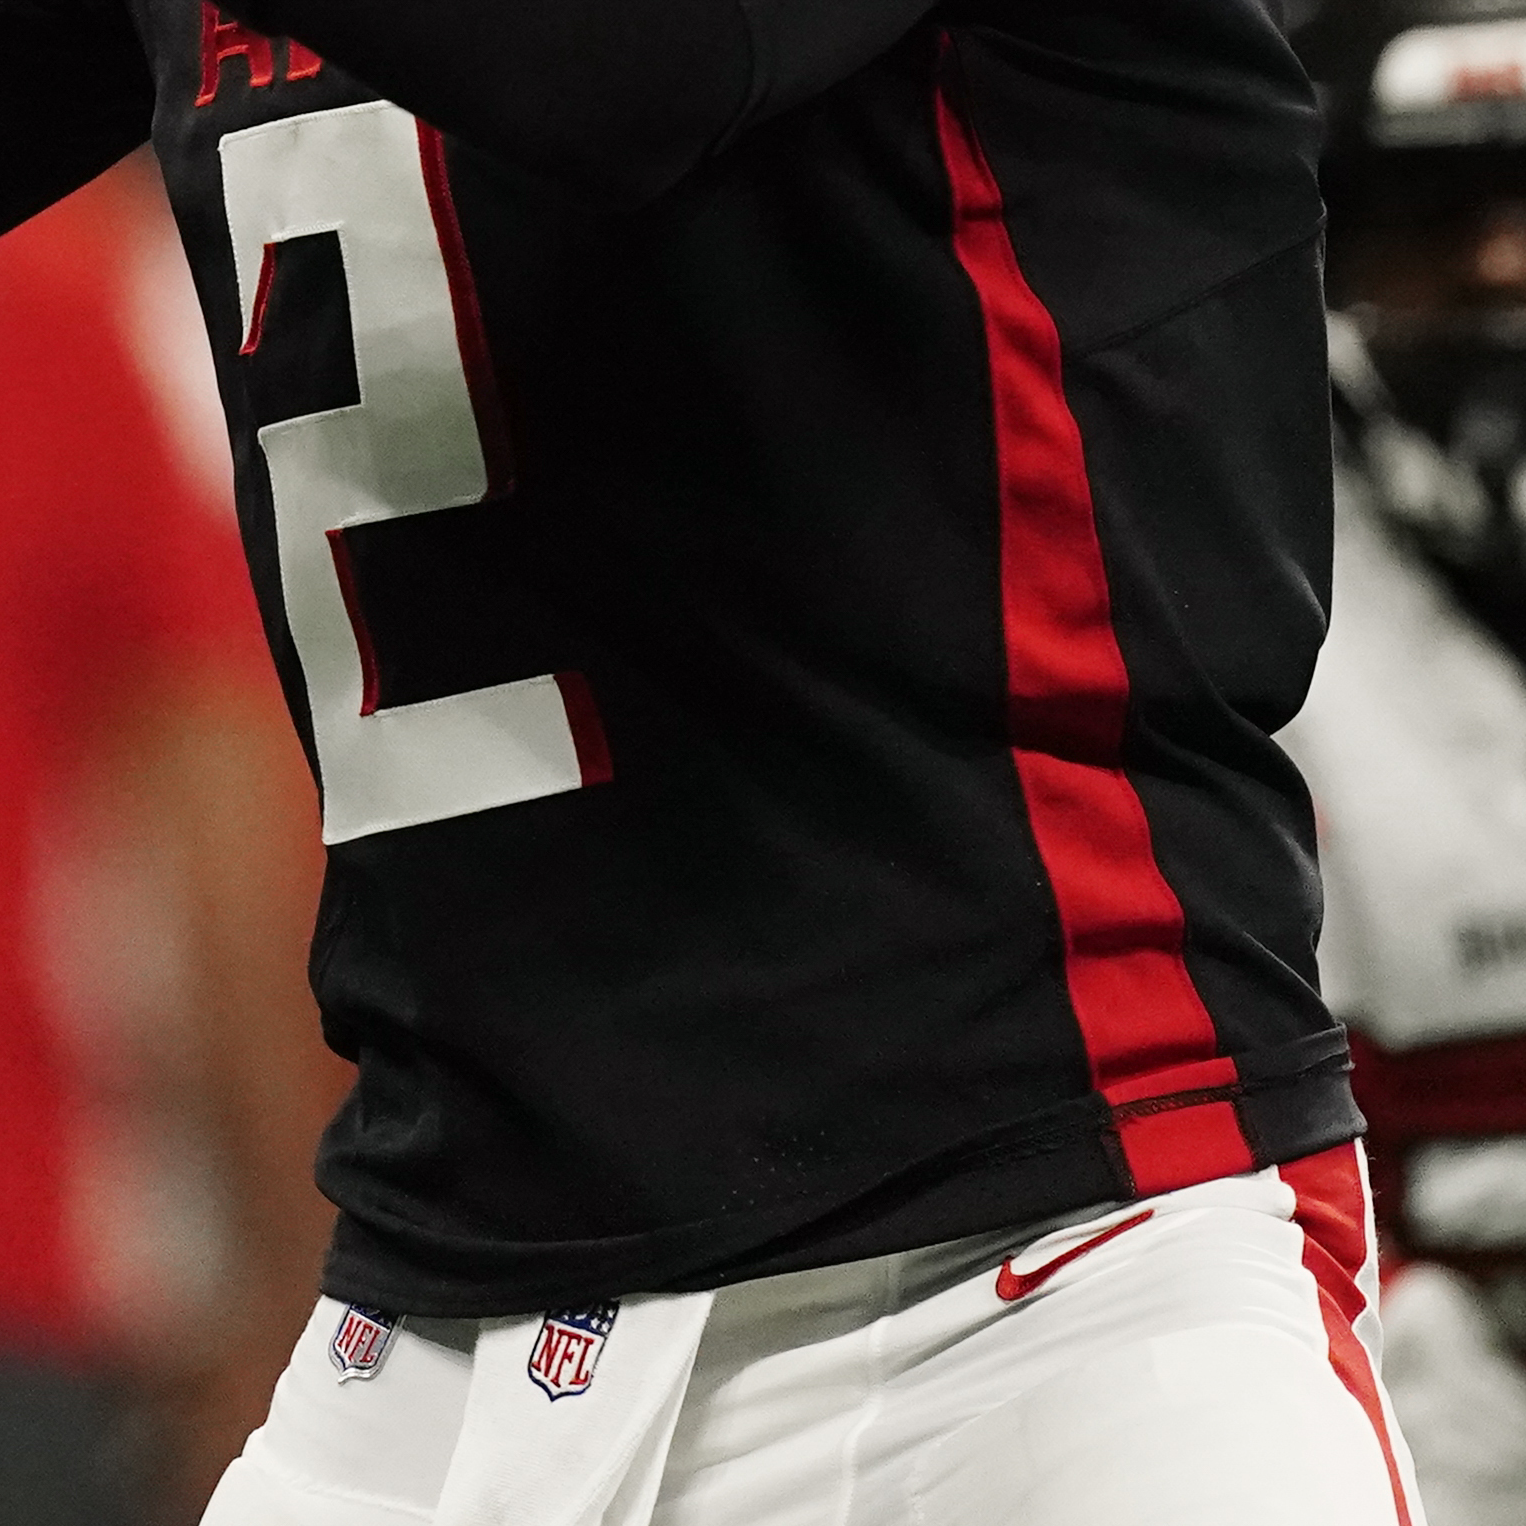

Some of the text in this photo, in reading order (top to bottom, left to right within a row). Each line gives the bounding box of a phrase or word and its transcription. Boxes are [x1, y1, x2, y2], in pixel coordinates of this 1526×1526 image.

[219, 99, 614, 846] 2
[337, 1315, 382, 1363] NFL
[531, 1324, 594, 1388] NFL
